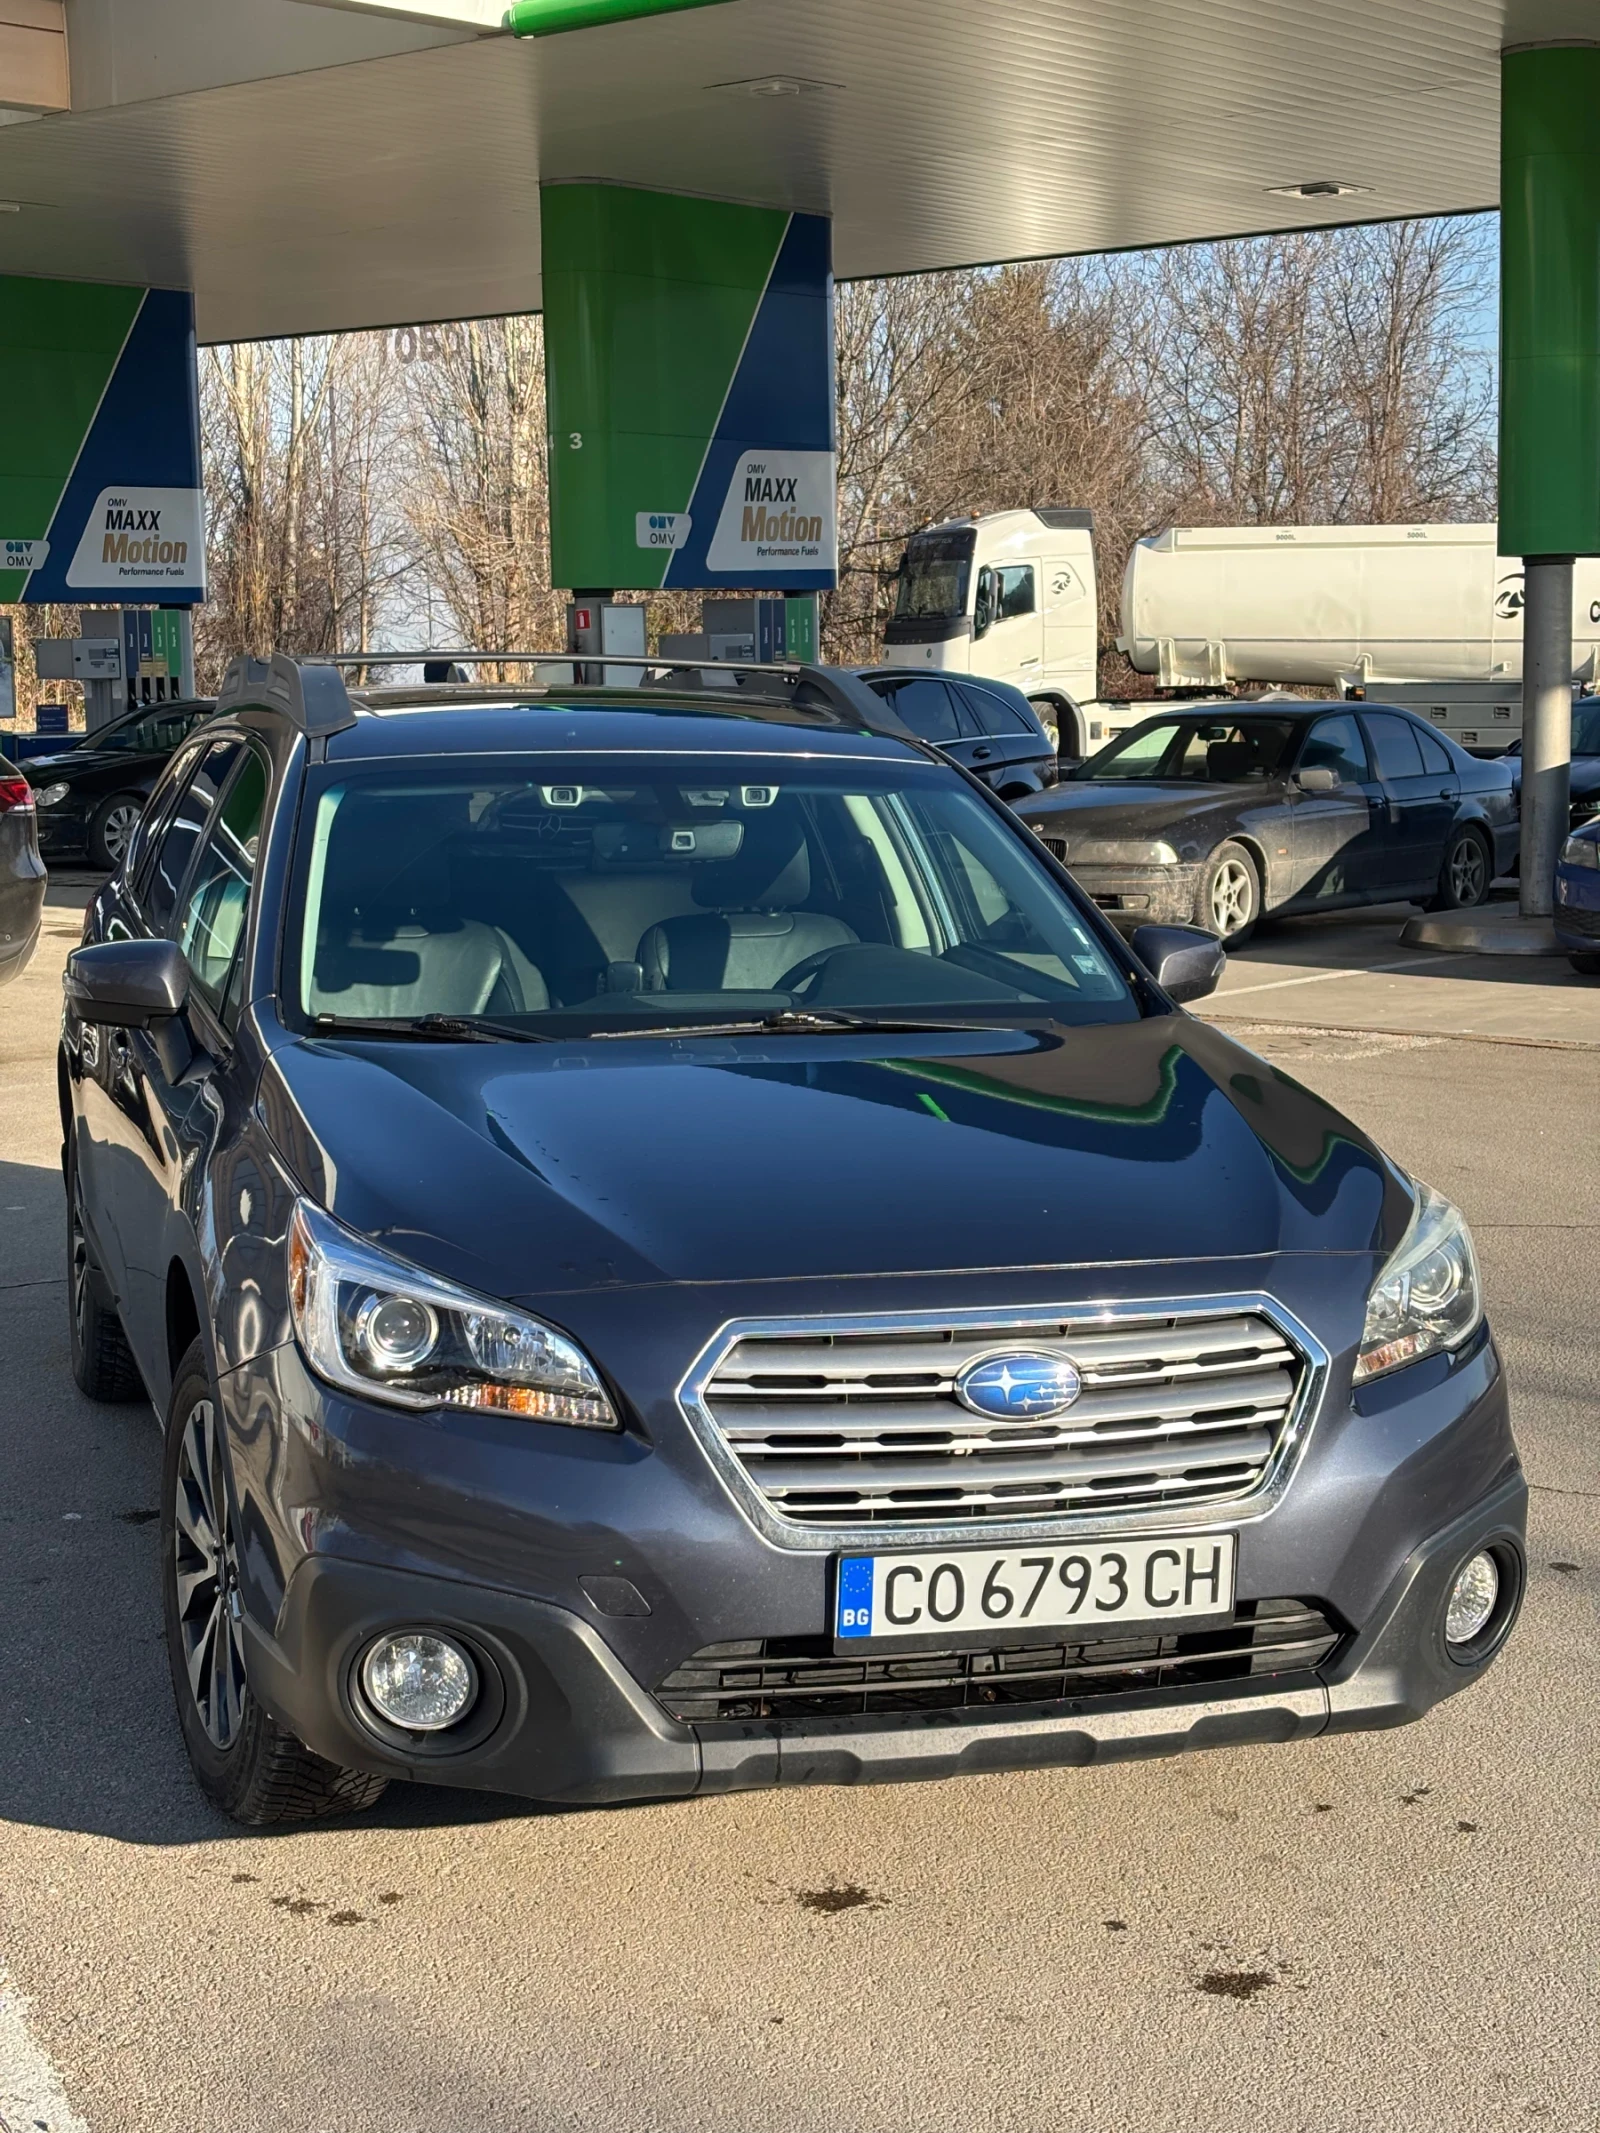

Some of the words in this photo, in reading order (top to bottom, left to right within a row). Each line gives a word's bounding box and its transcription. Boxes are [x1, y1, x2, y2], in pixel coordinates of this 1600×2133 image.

[569, 432, 583, 449] 3
[747, 464, 767, 474] OMV
[744, 477, 798, 502] MAXX
[107, 498, 128, 507] OMV
[105, 509, 161, 530] MAXX
[741, 505, 823, 542] Motion
[649, 533, 675, 545] OMV
[102, 533, 188, 564] Motion
[757, 545, 800, 556] Performance
[801, 545, 819, 556] Fuels
[7, 556, 33, 566] OMV
[119, 567, 164, 576] Performance
[165, 567, 185, 576] Fuels
[884, 1563, 965, 1626] CO
[980, 1552, 1128, 1619] 6793
[1144, 1544, 1222, 1608] CH
[843, 1608, 870, 1627] BG
